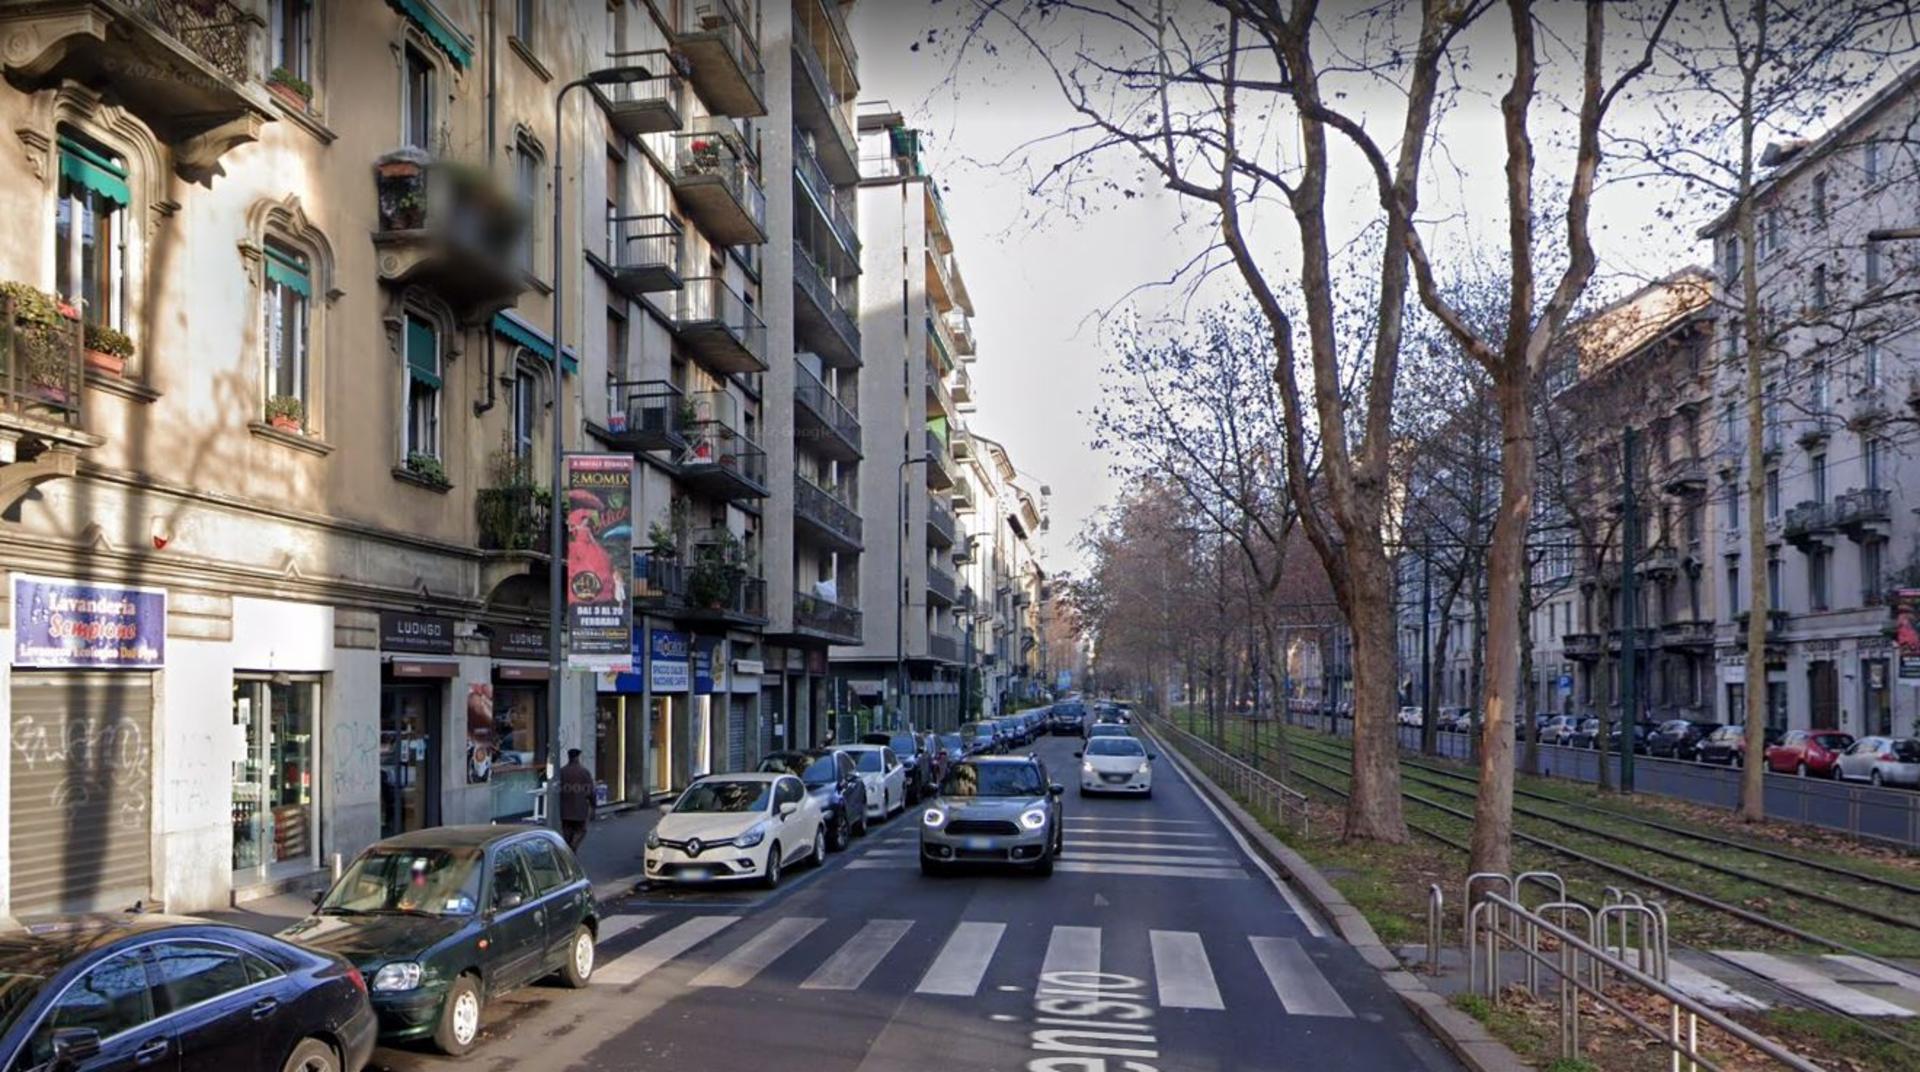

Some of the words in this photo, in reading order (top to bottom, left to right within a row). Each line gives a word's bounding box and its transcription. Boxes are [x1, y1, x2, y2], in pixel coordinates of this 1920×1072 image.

[581, 472, 629, 485] MOMIX
[48, 592, 137, 615] Lavanderia
[580, 617, 620, 626] FEBBRAIO
[397, 621, 443, 637] LUONGO
[509, 633, 543, 646] LUONGO
